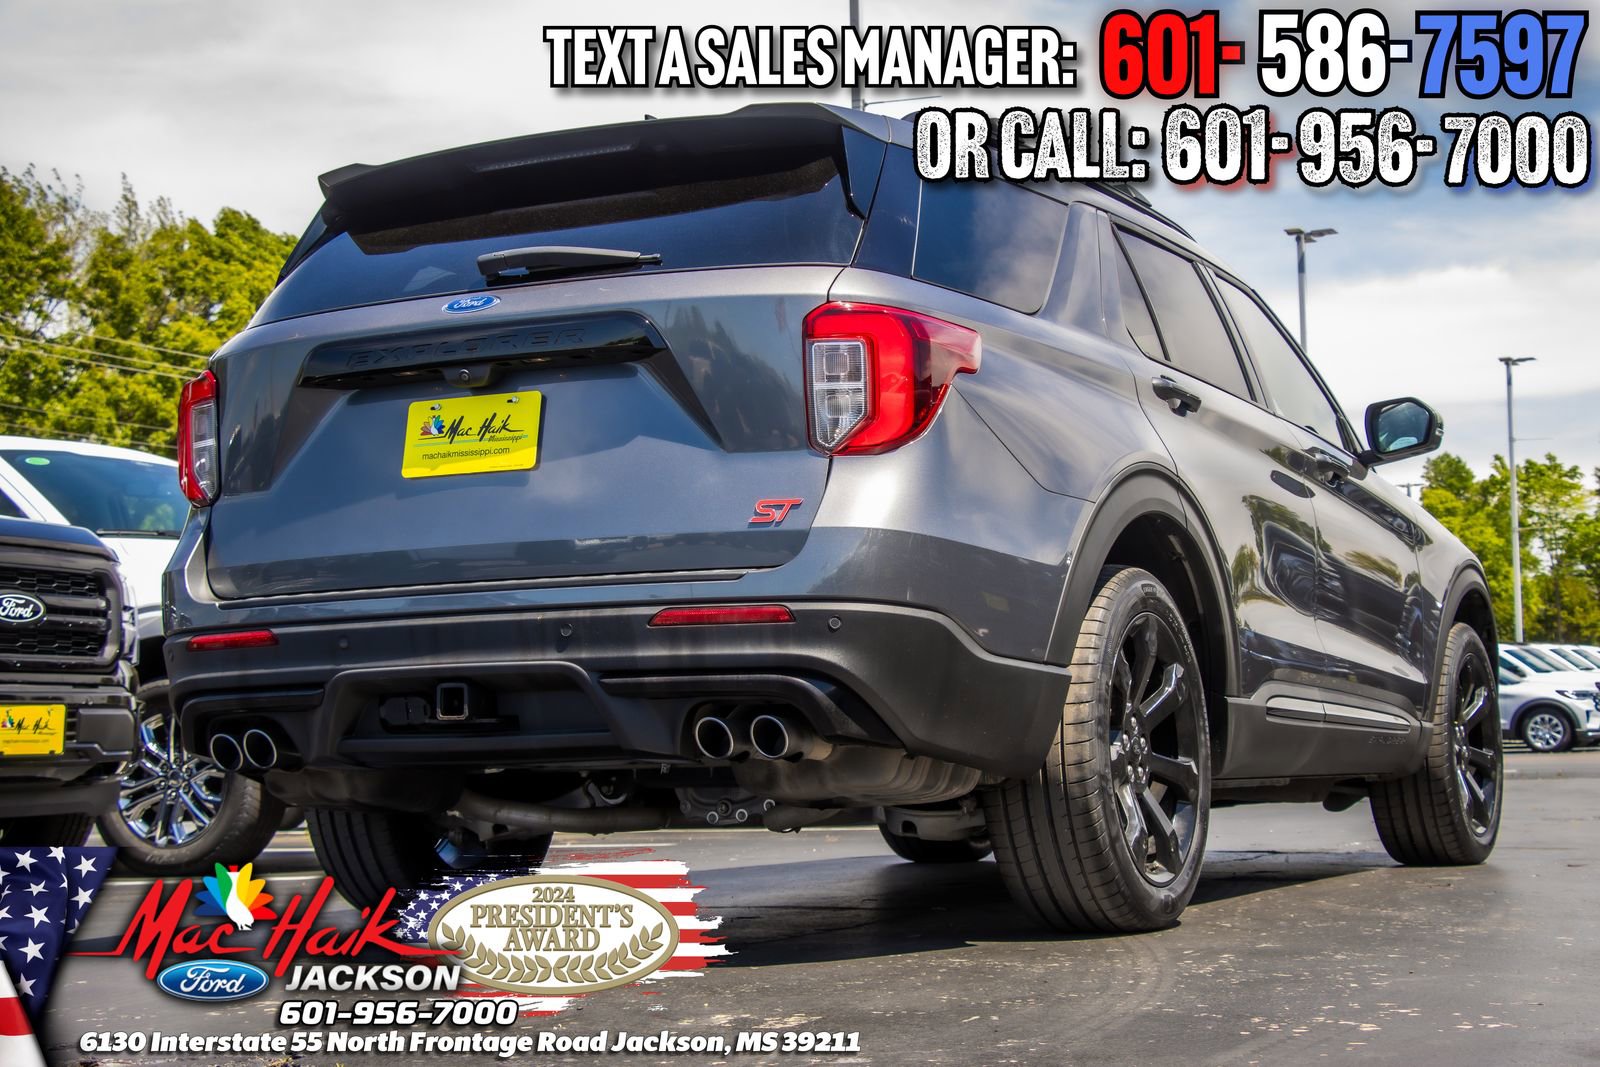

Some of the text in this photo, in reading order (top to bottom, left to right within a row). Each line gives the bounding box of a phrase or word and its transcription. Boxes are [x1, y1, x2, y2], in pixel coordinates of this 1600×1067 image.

[453, 296, 488, 309] Ford
[346, 328, 586, 368] EXPLORER
[443, 412, 524, 444] Mac Haik
[422, 447, 510, 460] machaikmississippi.com
[748, 498, 803, 522] ST
[0, 599, 34, 619] Ford
